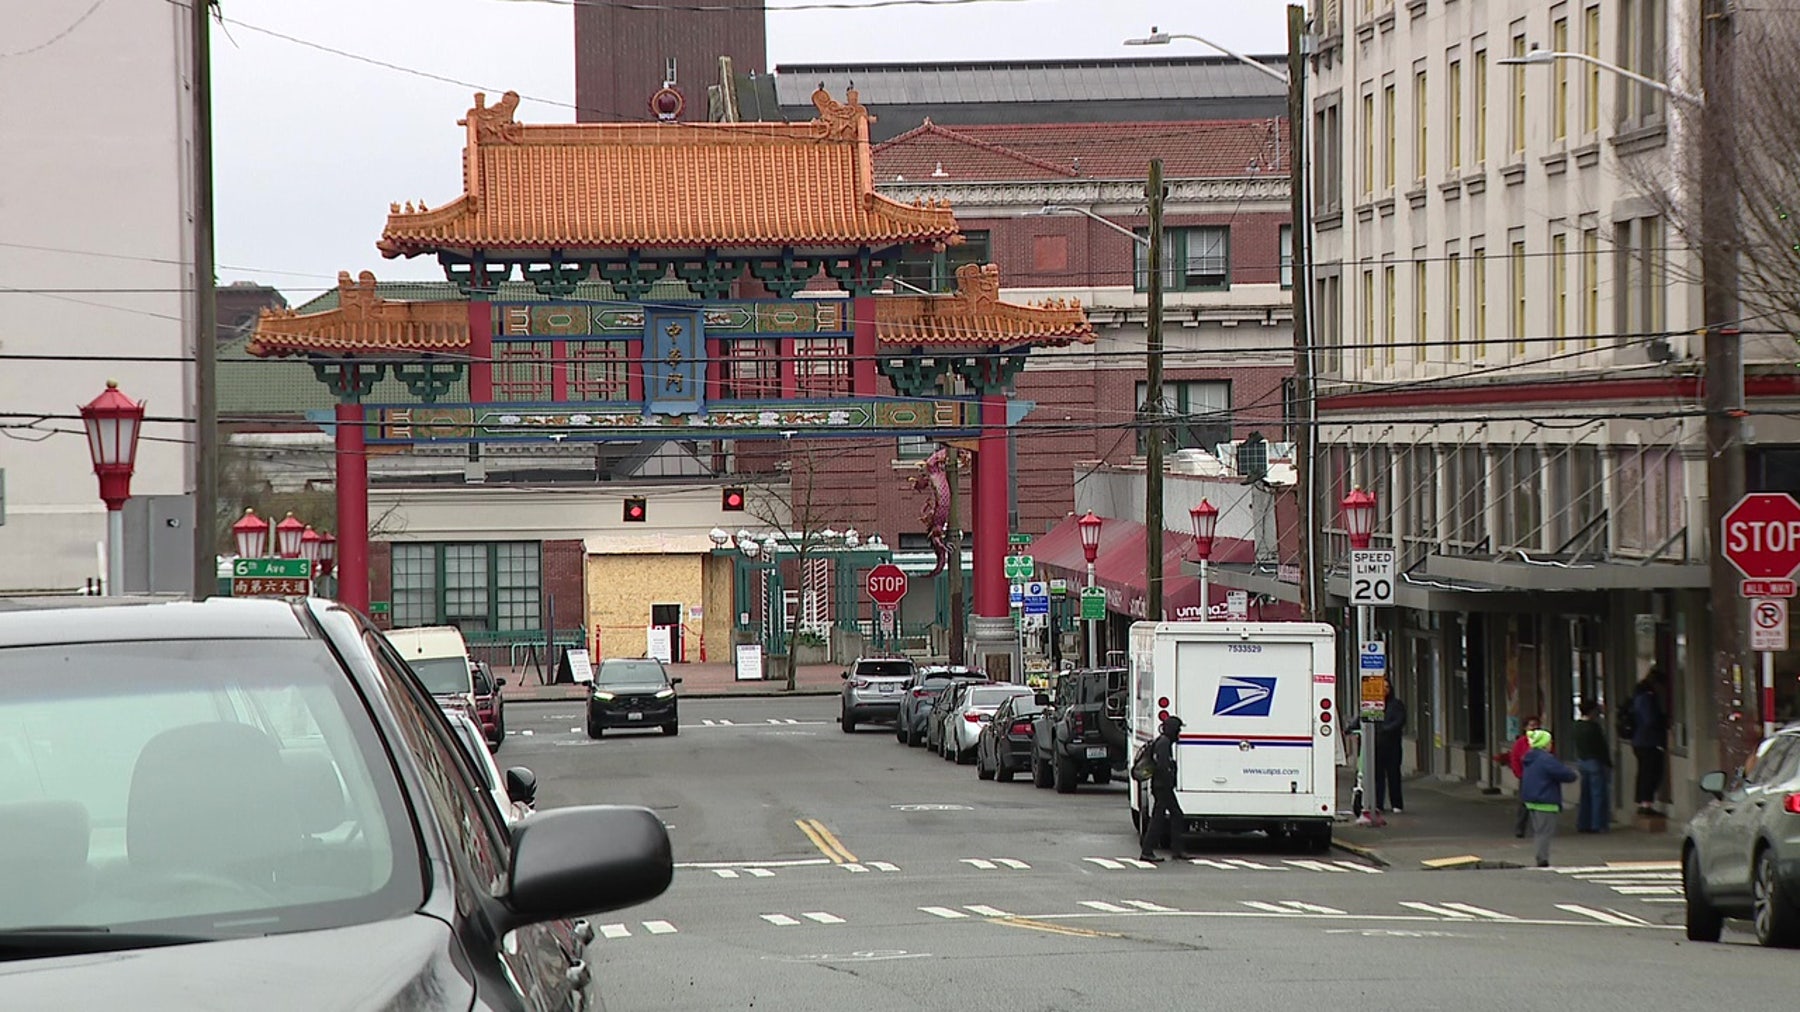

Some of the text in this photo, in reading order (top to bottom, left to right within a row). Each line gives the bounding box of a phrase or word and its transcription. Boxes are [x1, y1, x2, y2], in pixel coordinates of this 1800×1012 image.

[1729, 521, 1800, 552] STOP
[1354, 553, 1392, 562] SPEED
[265, 564, 286, 574] Ave
[299, 563, 307, 574] S
[1357, 565, 1388, 574] LIMIT
[870, 576, 904, 592] STOP
[1355, 580, 1391, 600] 20
[1227, 645, 1262, 653] 7533529
